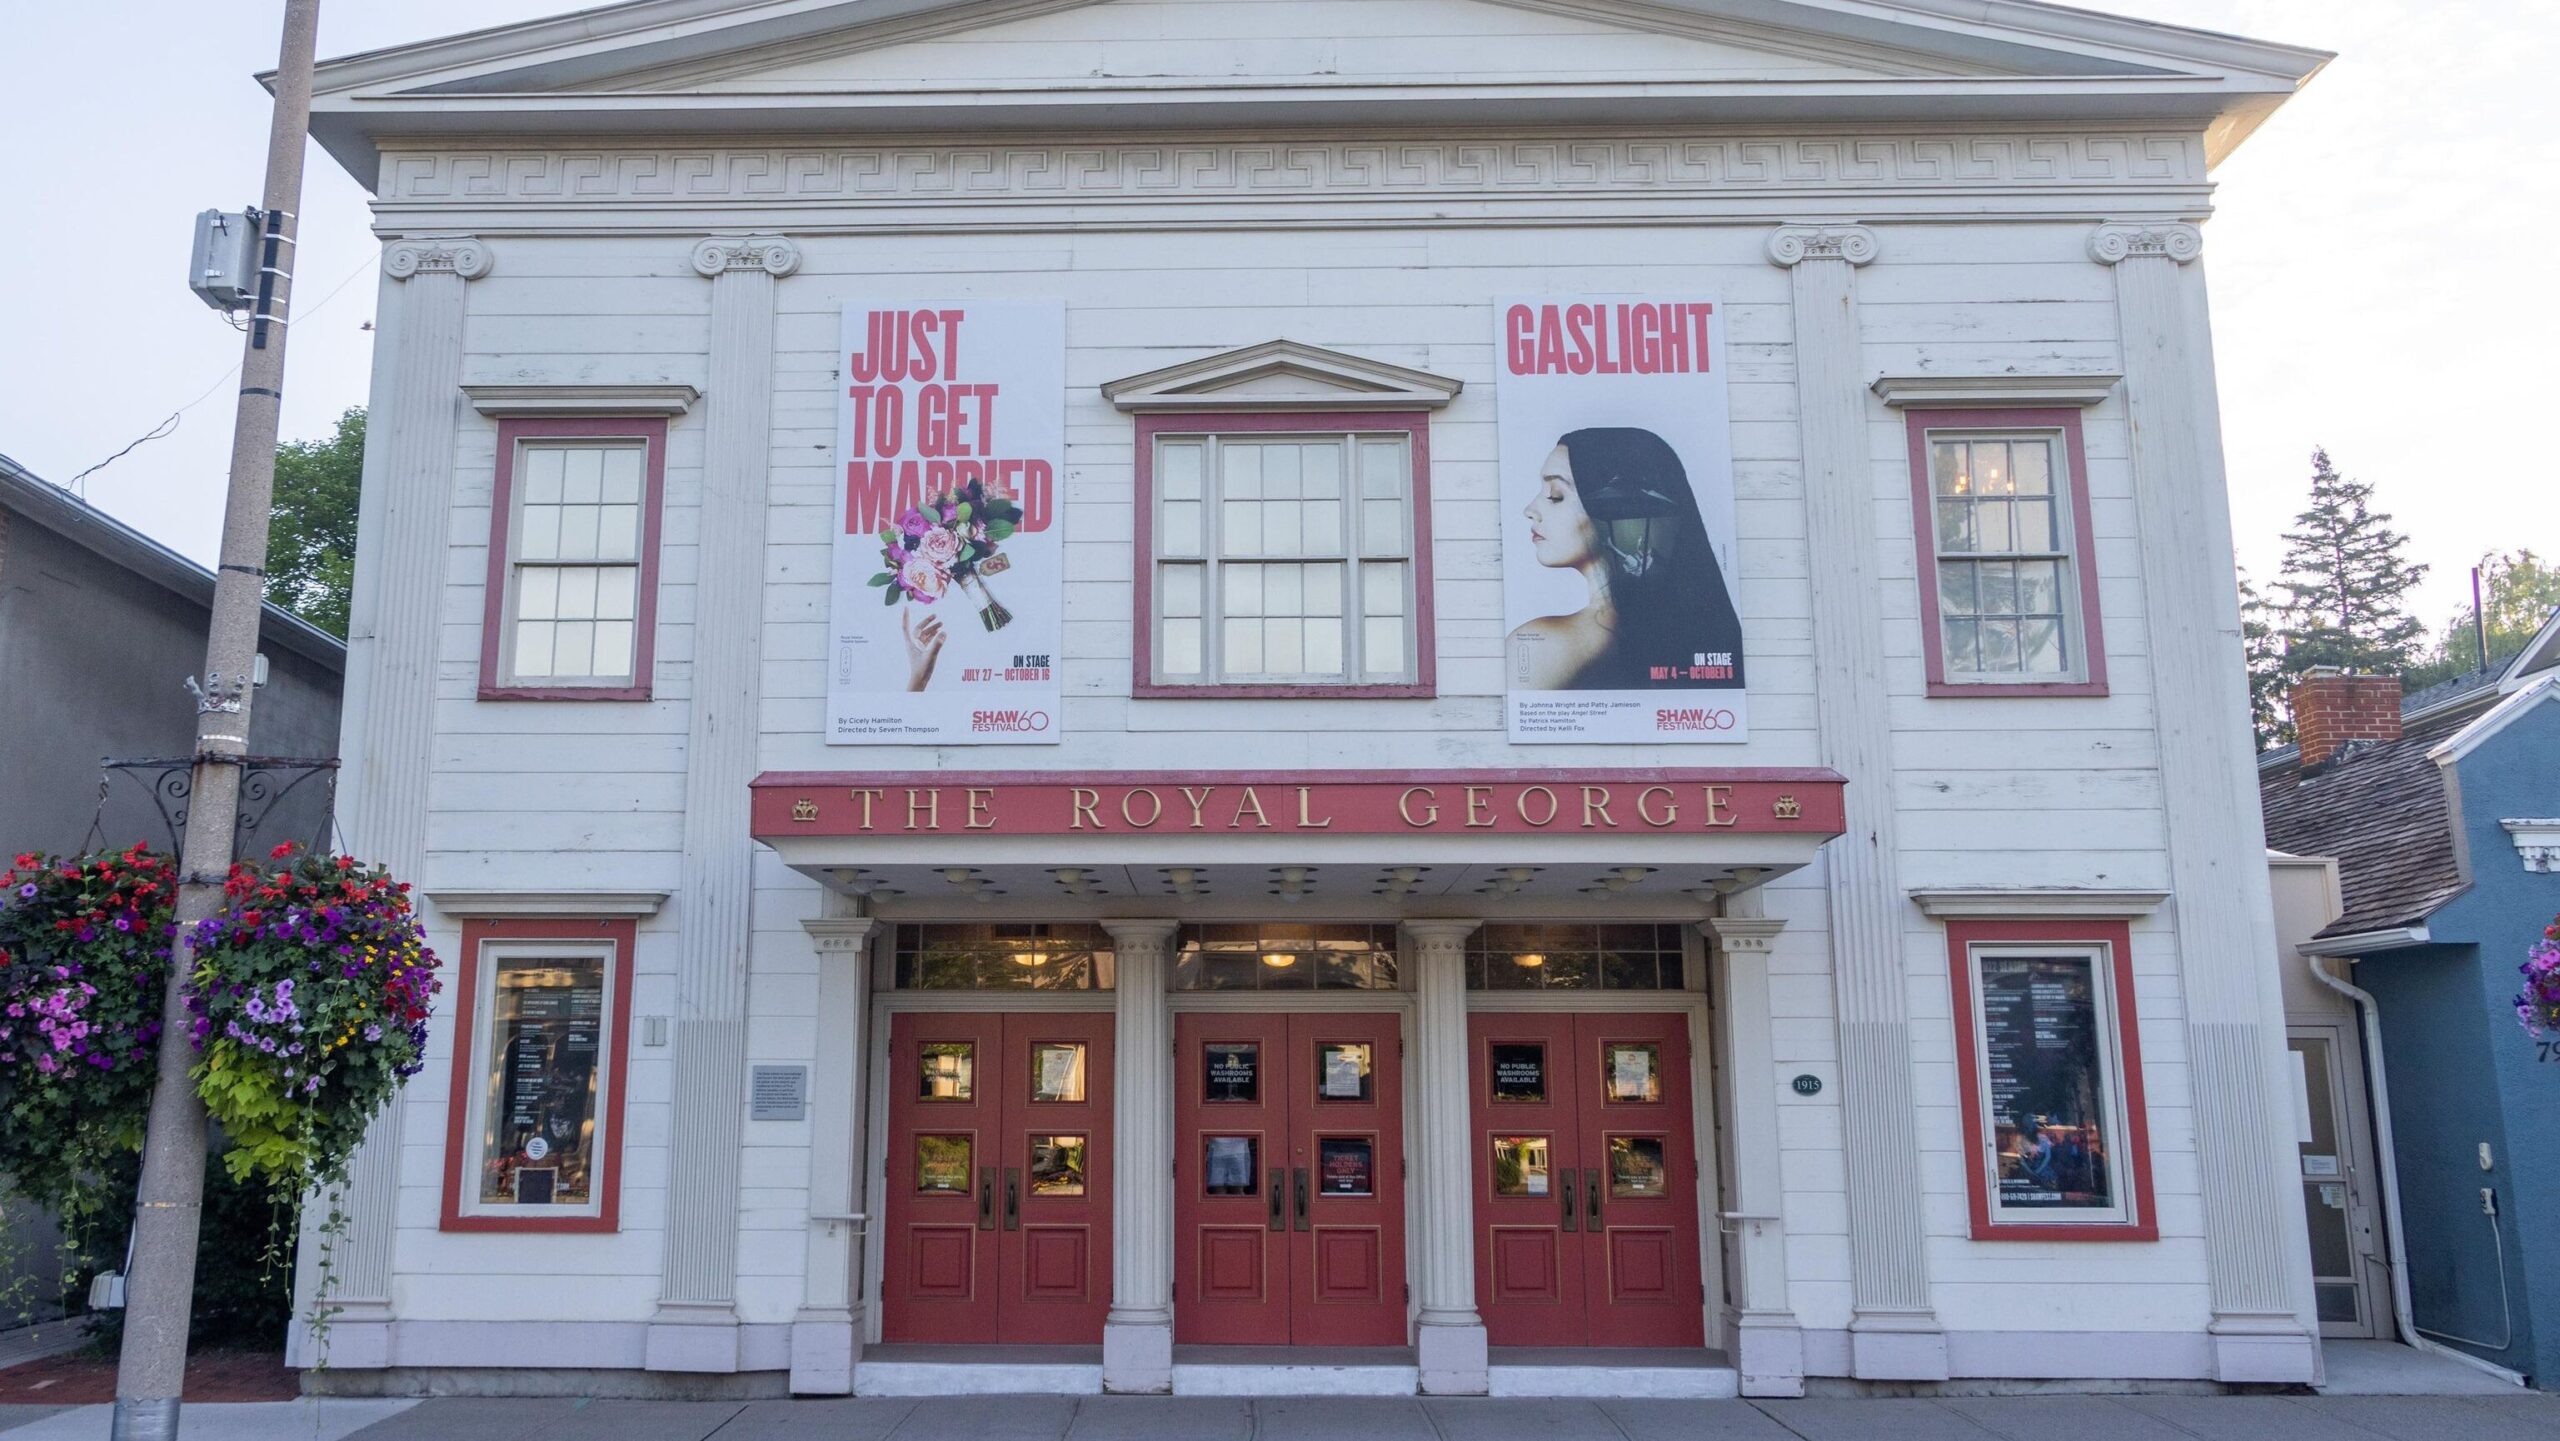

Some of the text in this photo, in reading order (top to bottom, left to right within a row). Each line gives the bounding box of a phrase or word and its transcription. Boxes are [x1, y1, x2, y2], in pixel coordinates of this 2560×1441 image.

[851, 309, 964, 383] JUST
[1506, 303, 1713, 376] GASLIGHT
[849, 384, 999, 458] TO GET
[1013, 655, 1050, 667] ON STAGE
[1694, 652, 1733, 666] ON STAGE
[962, 668, 980, 681] JULY
[983, 668, 992, 681] 27
[1004, 668, 1040, 681] OCTOBER
[1042, 668, 1050, 681] 16
[1650, 666, 1668, 680] MAY
[1671, 666, 1678, 680] 4
[1690, 666, 1726, 680] OCTOBER
[1591, 701, 1608, 709] Patty
[972, 711, 1018, 723] SHAW
[1018, 710, 1049, 731] 60
[1656, 709, 1703, 722] SHAW
[1703, 708, 1735, 730] 60
[904, 726, 940, 734] Thompson
[971, 723, 1019, 731] FESTIVAL
[1656, 722, 1704, 730] FESTIVAL
[851, 785, 1738, 830] THE ROYAL GEORGE
[1796, 1080, 1819, 1090] 1915
